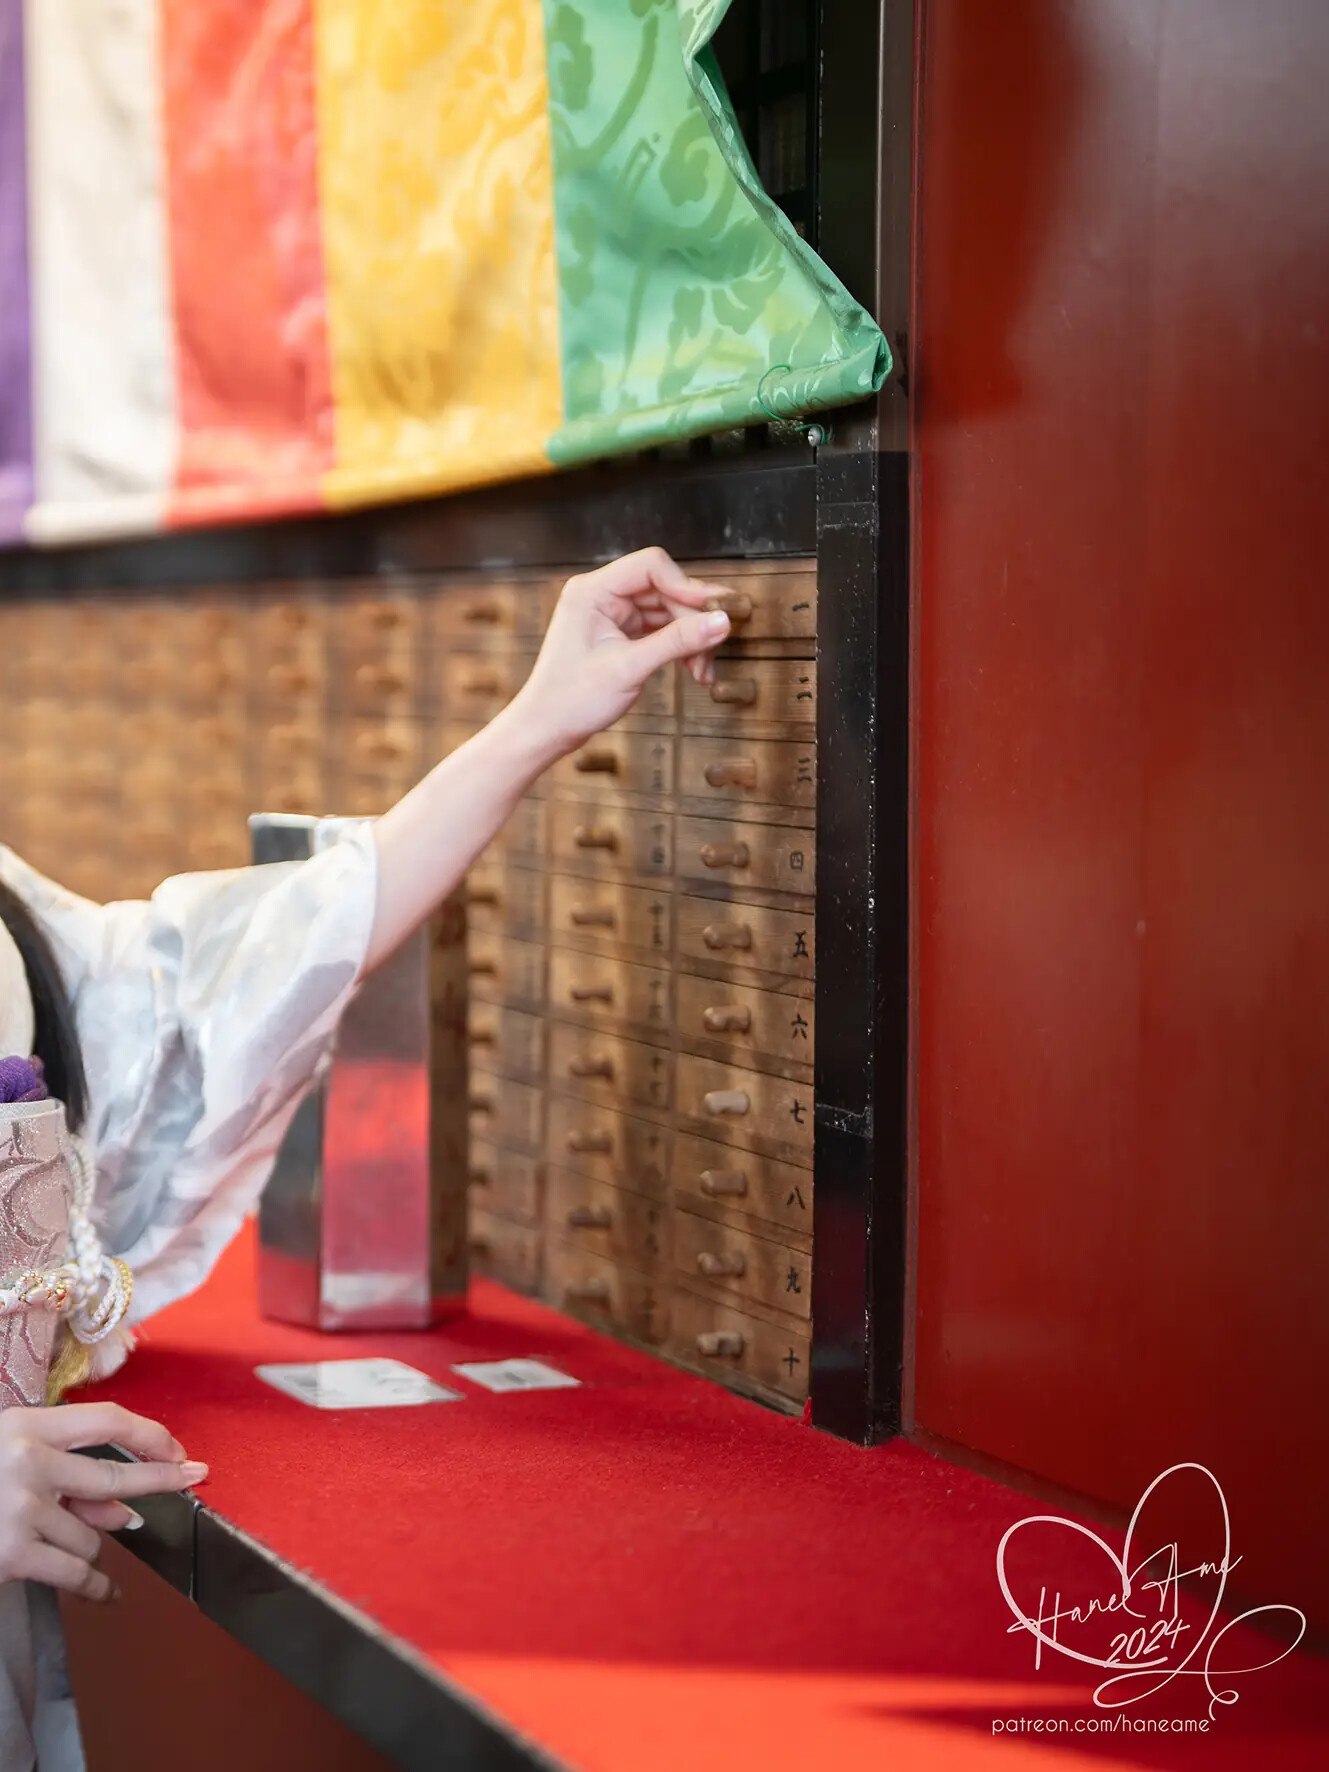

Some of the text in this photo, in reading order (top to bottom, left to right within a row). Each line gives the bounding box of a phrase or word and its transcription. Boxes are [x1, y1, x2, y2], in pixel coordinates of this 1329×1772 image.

[796, 676, 812, 700] 二
[797, 757, 812, 782] 三
[790, 851, 805, 872] 四
[792, 930, 809, 958] 五
[791, 1012, 809, 1039] 六
[789, 1099, 808, 1124] 七
[786, 1186, 806, 1210] 八
[785, 1265, 802, 1294] 九
[781, 1347, 801, 1377] 十
